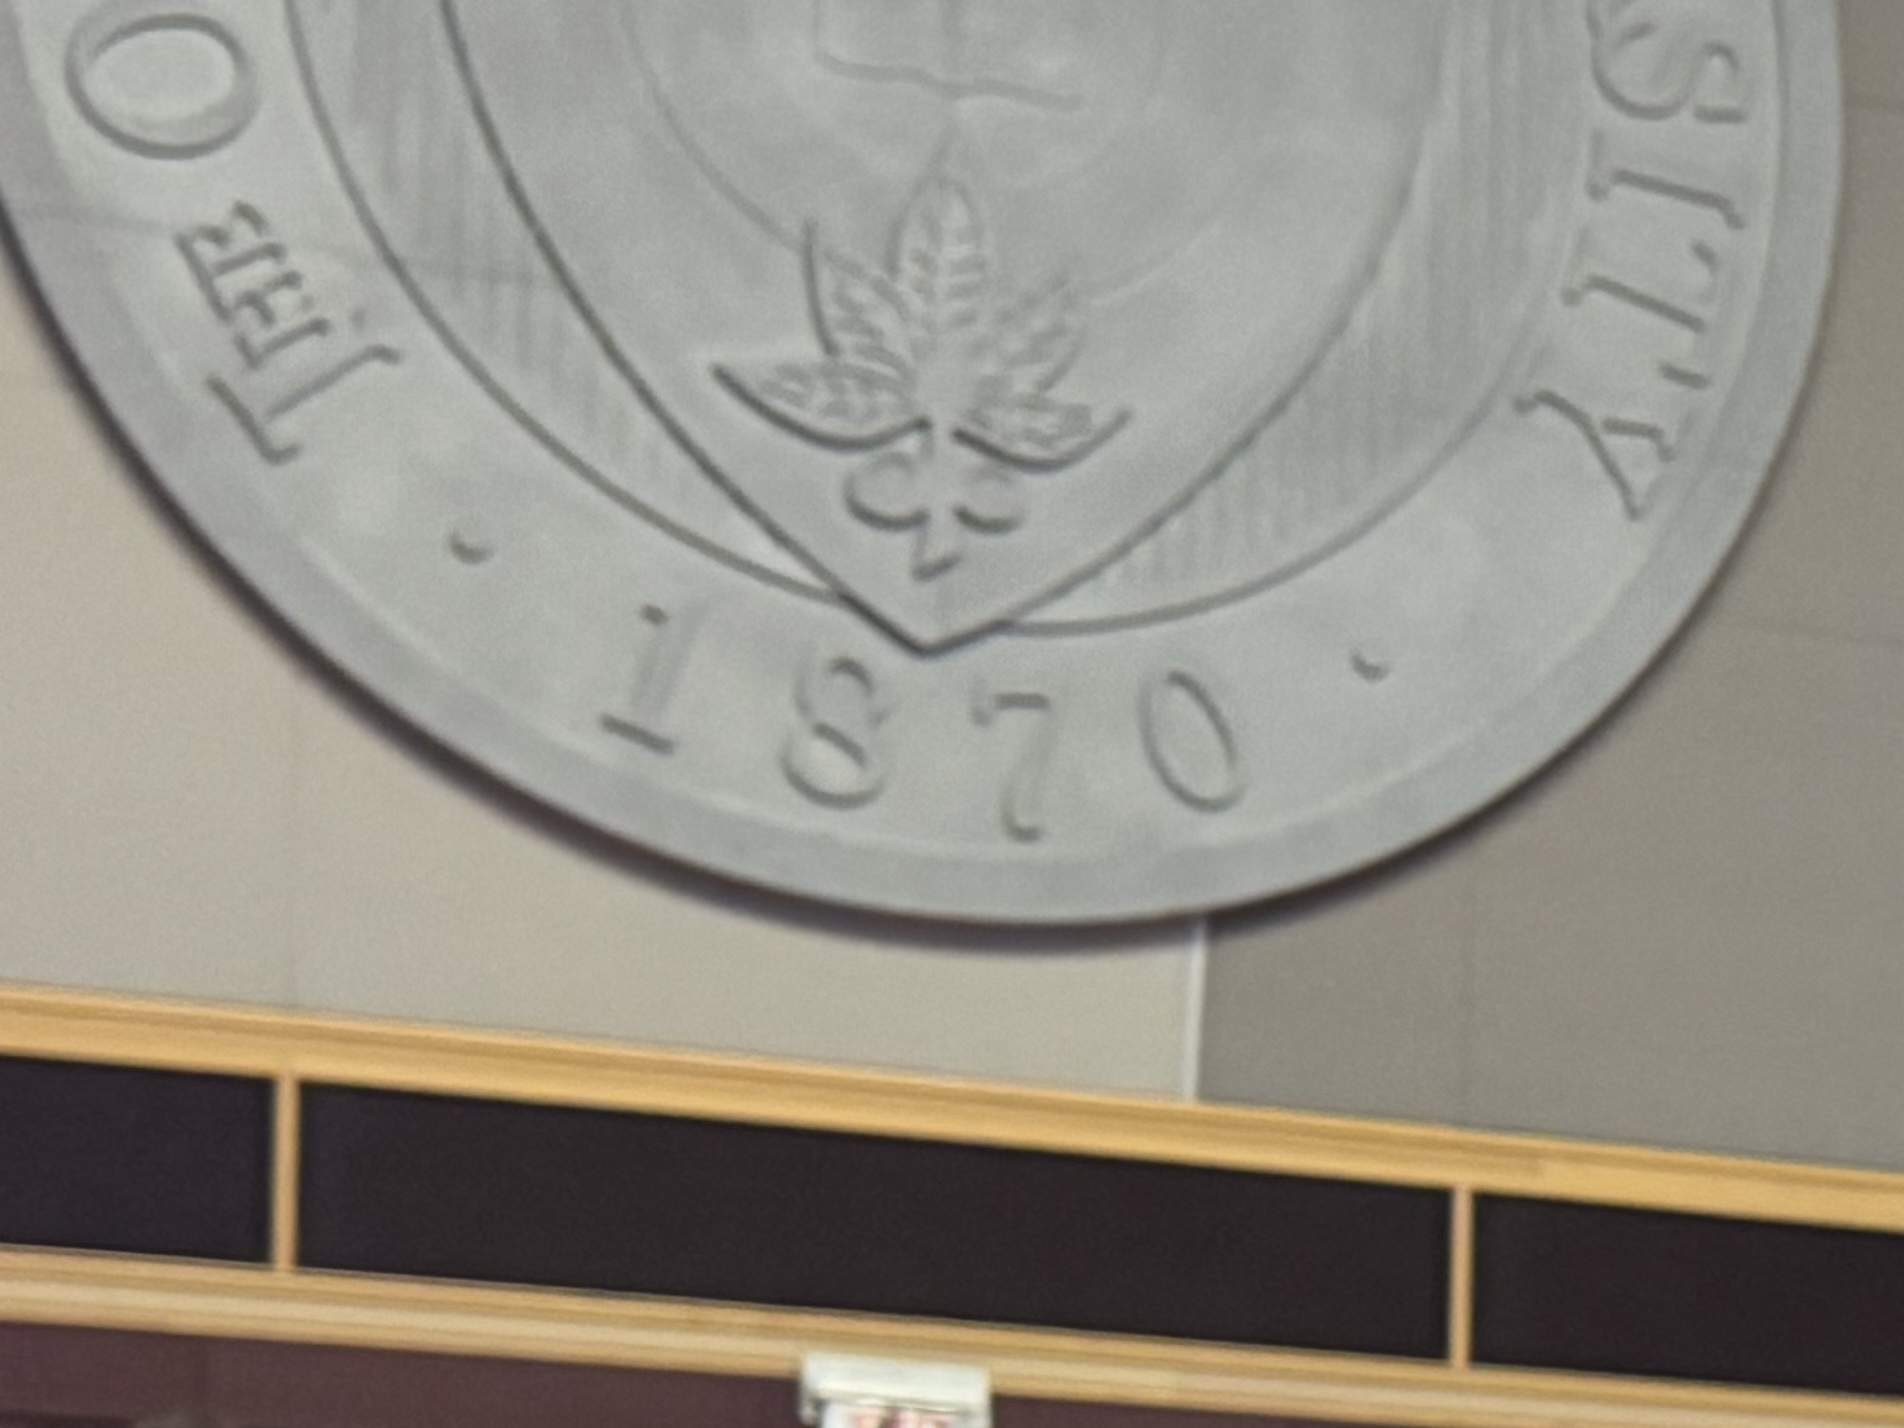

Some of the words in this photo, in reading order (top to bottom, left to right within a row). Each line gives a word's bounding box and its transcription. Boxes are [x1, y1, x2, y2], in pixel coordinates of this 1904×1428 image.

[174, 200, 402, 466] THE
[1514, 0, 1748, 521] SITY
[599, 603, 1248, 842] 1870
